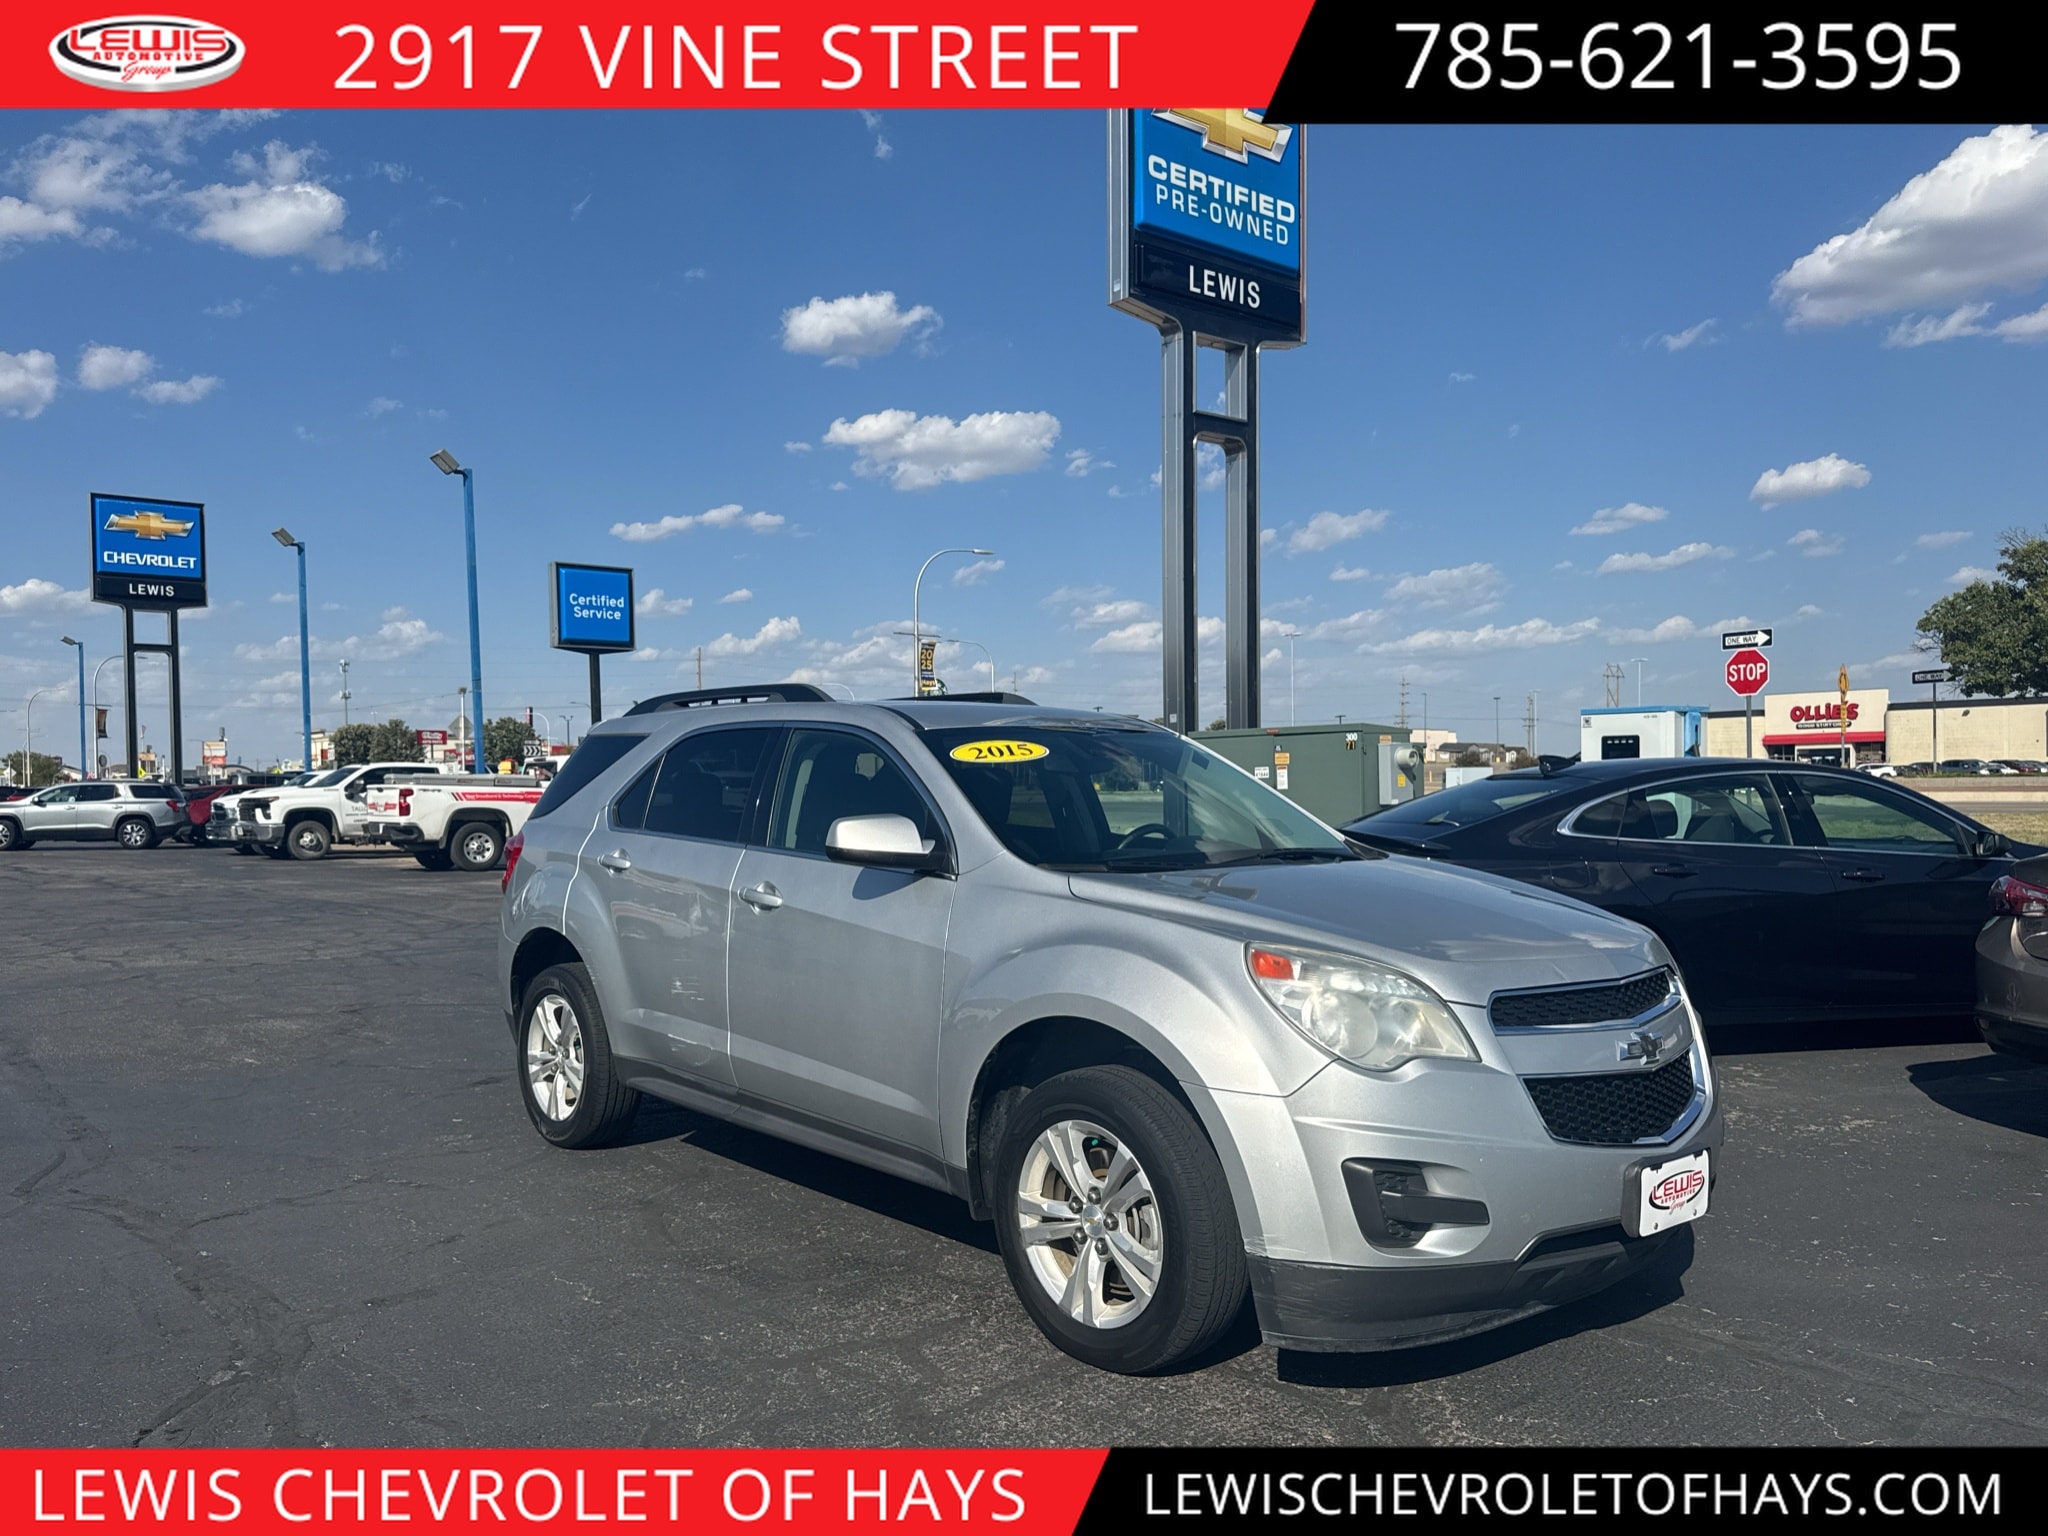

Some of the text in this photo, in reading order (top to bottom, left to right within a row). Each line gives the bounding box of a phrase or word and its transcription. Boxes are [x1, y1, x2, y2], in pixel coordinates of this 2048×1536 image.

[1148, 154, 1296, 223] CERTIFIED
[1156, 183, 1289, 246] PRE-OWNED
[1189, 265, 1261, 309] LEWIS
[103, 550, 197, 569] CHEVROLET
[129, 583, 175, 597] LEWIS
[569, 593, 625, 608] Certified
[573, 606, 622, 620] Service
[1726, 635, 1757, 646] ONE WAY
[1728, 662, 1766, 682] STOP
[1345, 732, 1358, 741] 300
[968, 743, 1034, 760] 2015
[1652, 1170, 1702, 1200] LEWIS
[1661, 1188, 1696, 1204] AUTOMOTIVE
